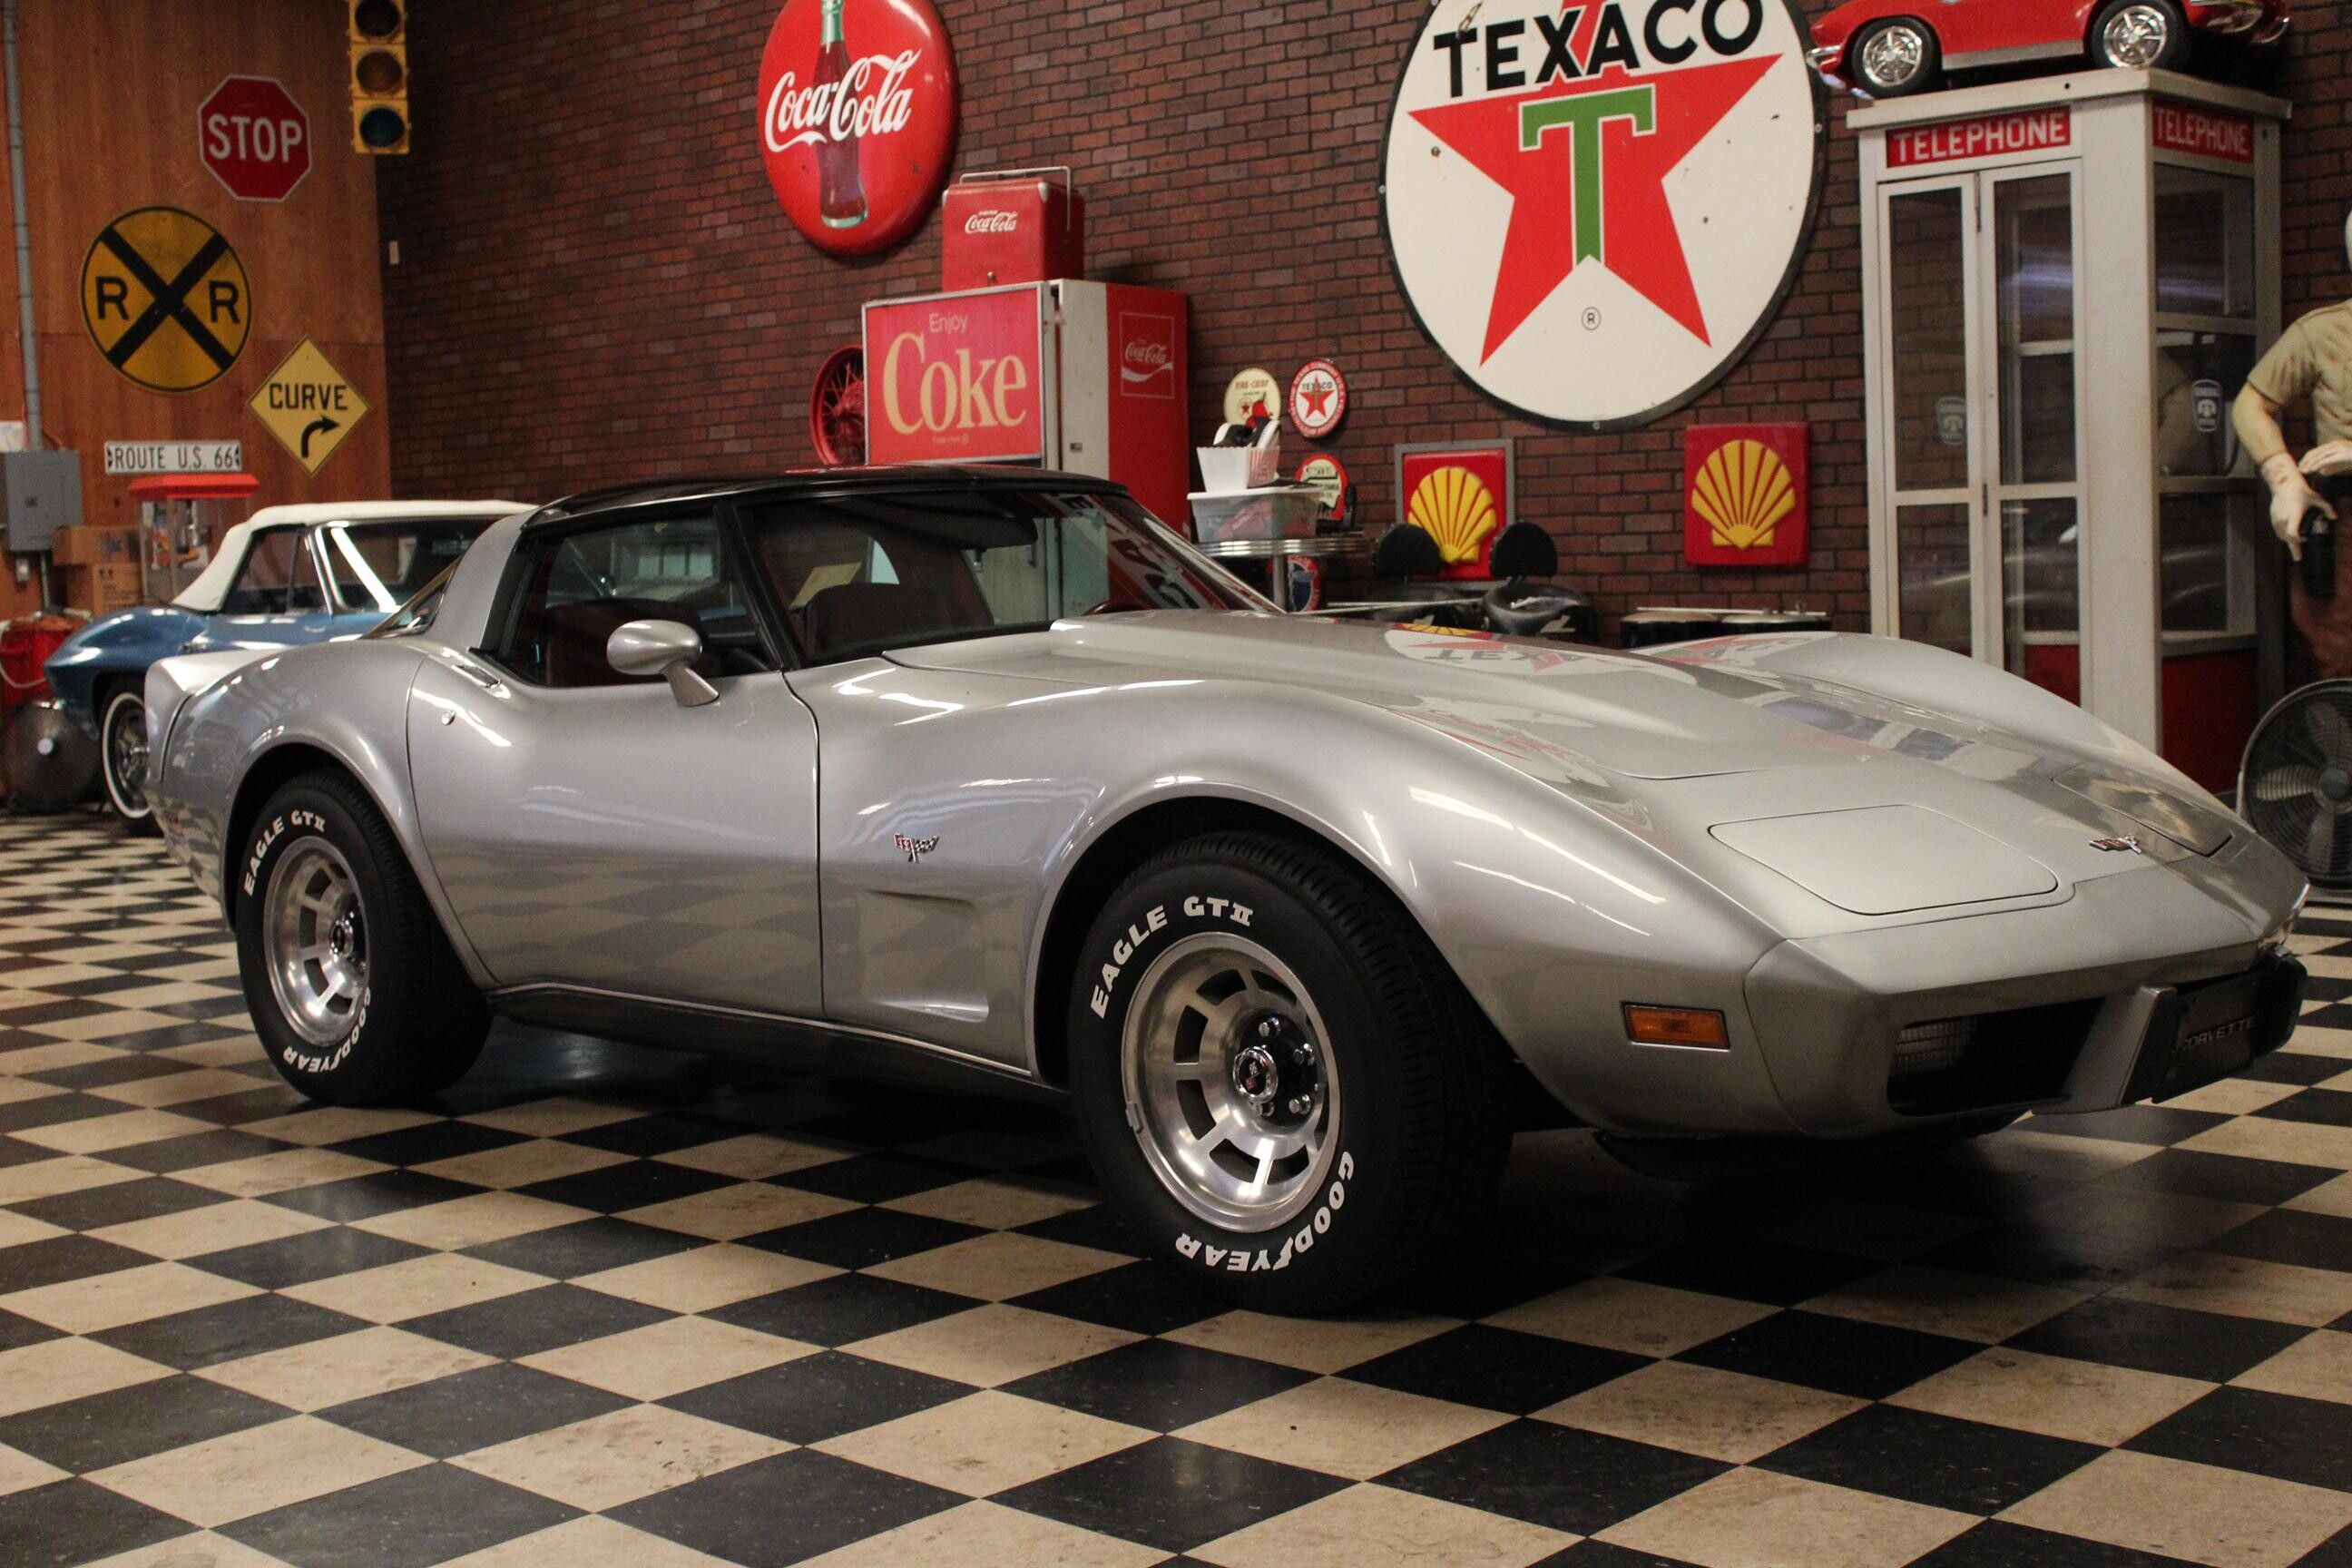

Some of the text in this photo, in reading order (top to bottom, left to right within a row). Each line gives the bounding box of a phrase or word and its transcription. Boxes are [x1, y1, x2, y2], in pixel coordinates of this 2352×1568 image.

[1433, 0, 1763, 98] TEXACO
[764, 47, 922, 152] Coca-Cola
[2153, 107, 2249, 155] TELEPHONE
[208, 114, 302, 163] STOP
[1893, 112, 2065, 162] TELEPHONE
[96, 276, 240, 324] R R
[928, 312, 967, 335] Enjoy
[270, 383, 348, 412] CURVE
[882, 332, 1027, 436] Coke
[114, 446, 233, 469] ROUTE U.S. 66
[244, 816, 285, 897] EAGLE
[1091, 905, 1168, 1019] EAGLE
[283, 986, 371, 1073] GOODYEAR
[1175, 1151, 1355, 1272] GOODYEAR
